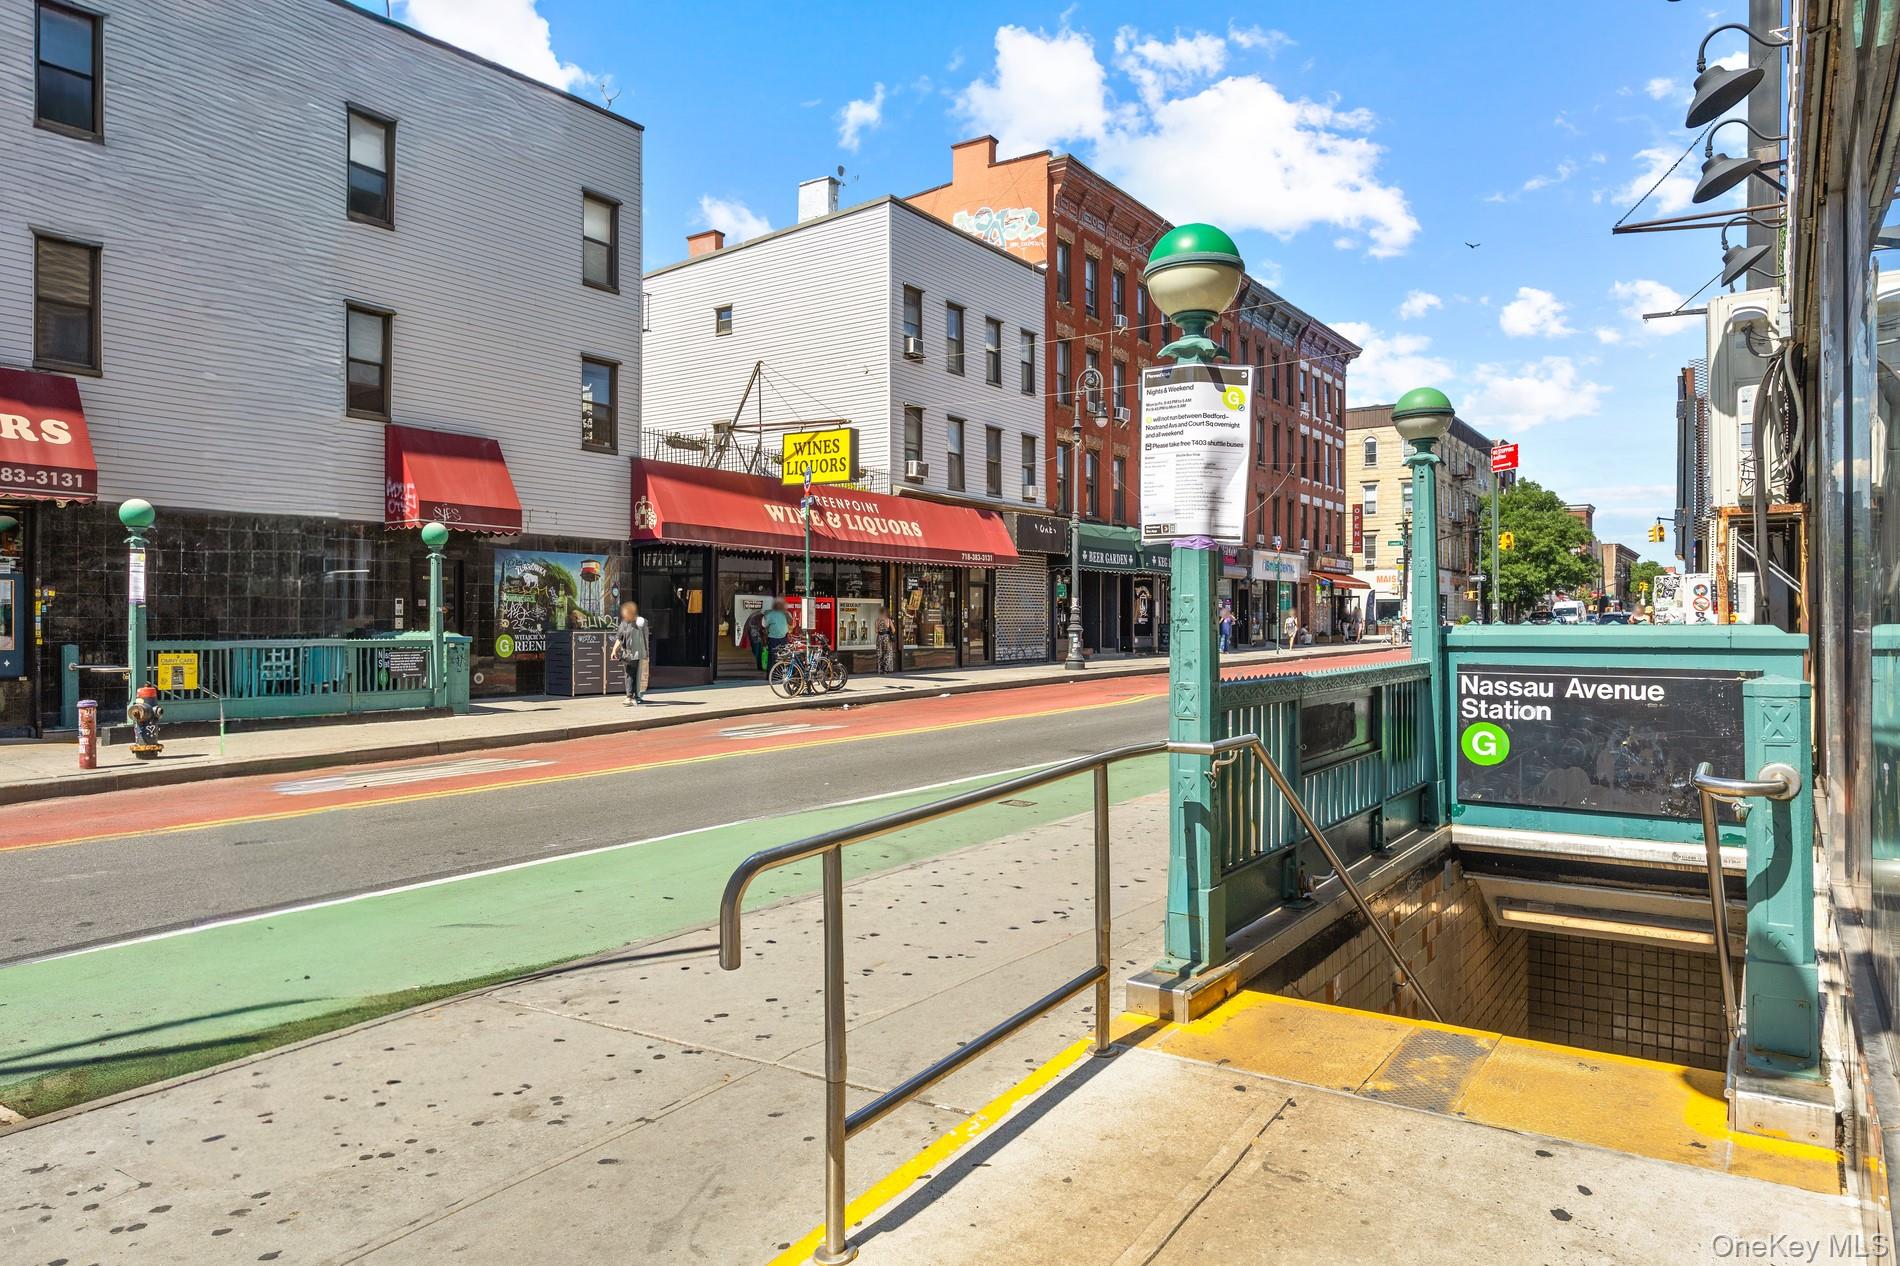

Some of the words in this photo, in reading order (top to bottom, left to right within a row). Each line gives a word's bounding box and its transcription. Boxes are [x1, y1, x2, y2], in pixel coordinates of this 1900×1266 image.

[1146, 387, 1164, 396] Nights
[1168, 384, 1194, 393] Weekend
[1227, 391, 1239, 405] G
[0, 413, 72, 445] RS
[1145, 423, 1168, 431] Nostrand
[1214, 421, 1240, 429] overnight
[1161, 429, 1184, 437] weekend
[793, 438, 840, 456] WINES
[786, 456, 847, 476] LIQUORS
[0, 467, 83, 488] 83-3131
[813, 495, 880, 514] REENPOINT
[826, 511, 842, 529] &
[843, 513, 923, 537] LIQUORS
[1088, 551, 1104, 563] BEER
[1105, 552, 1128, 565] GARDEN
[1461, 675, 1554, 698] Nassau
[1564, 678, 1665, 701] Avenue
[1461, 698, 1552, 721] Station
[1471, 731, 1497, 756] G
